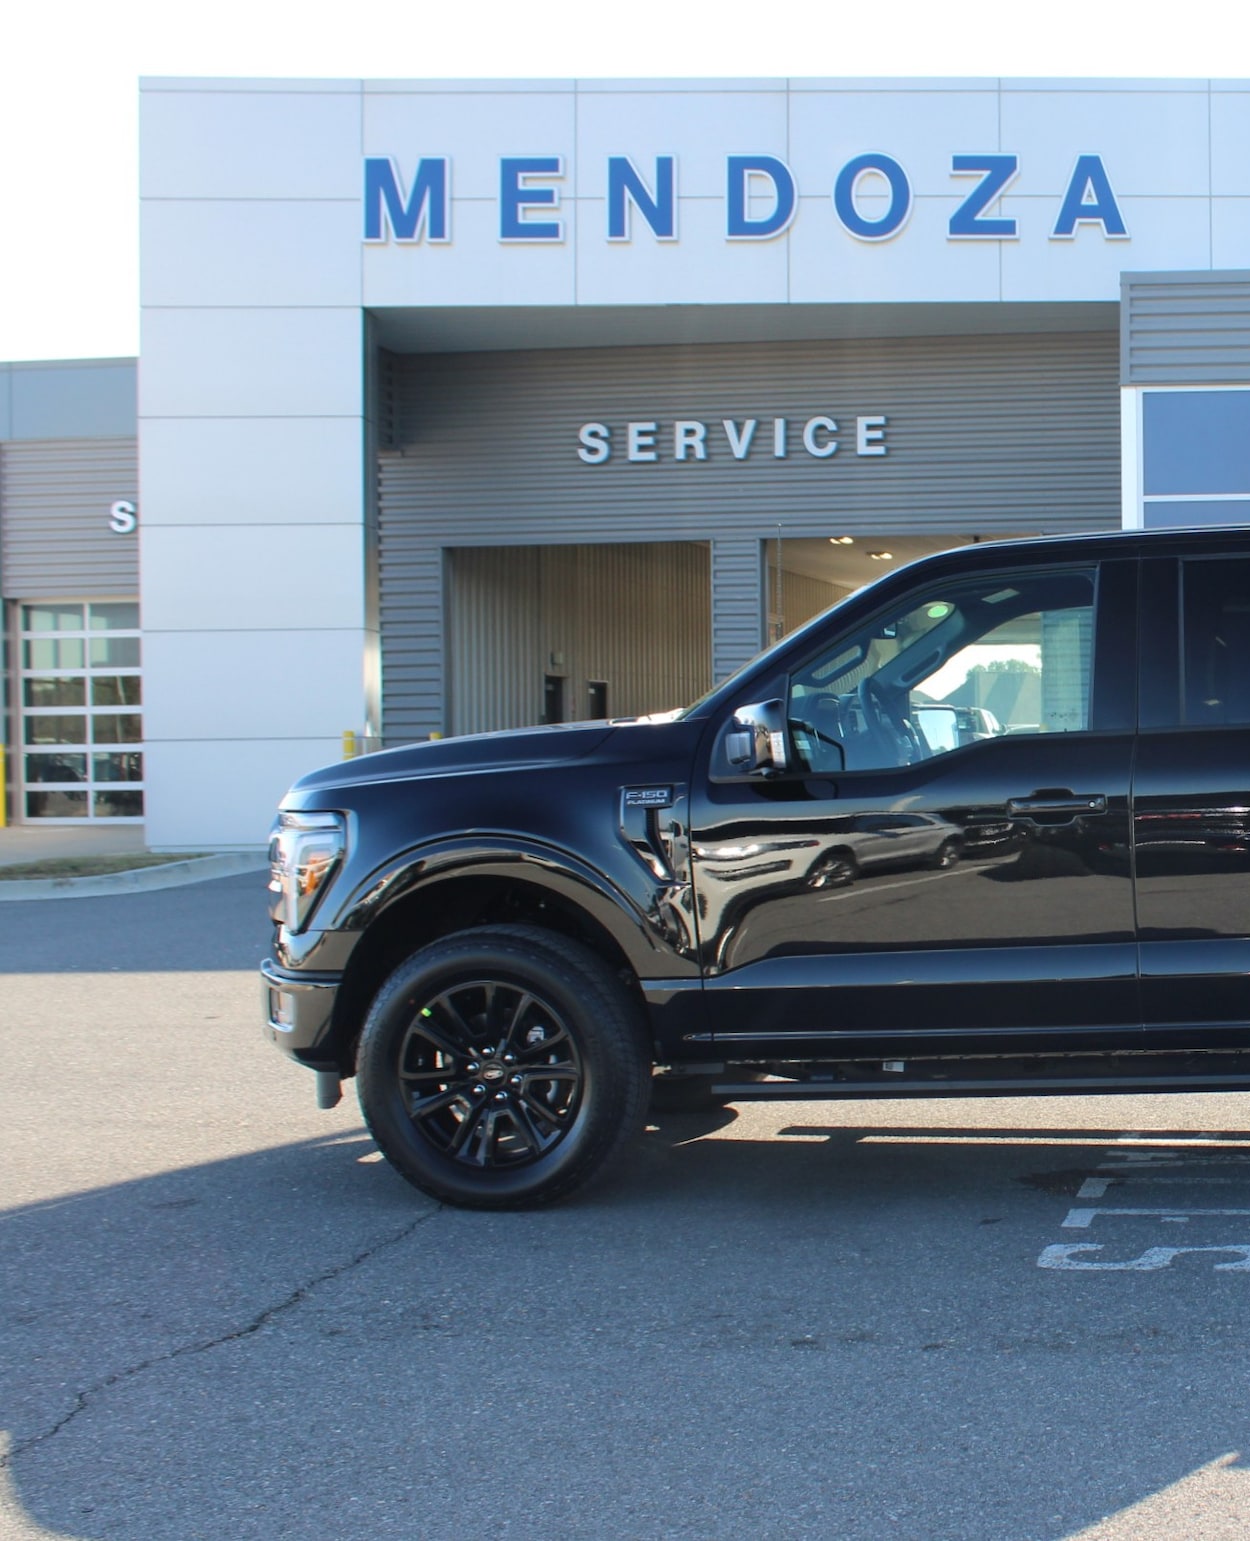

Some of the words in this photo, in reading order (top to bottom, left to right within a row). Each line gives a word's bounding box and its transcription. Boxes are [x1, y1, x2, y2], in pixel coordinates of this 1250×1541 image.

[363, 152, 1130, 243] MENDOZA
[577, 415, 888, 465] SERVICE
[626, 790, 668, 799] F-150
